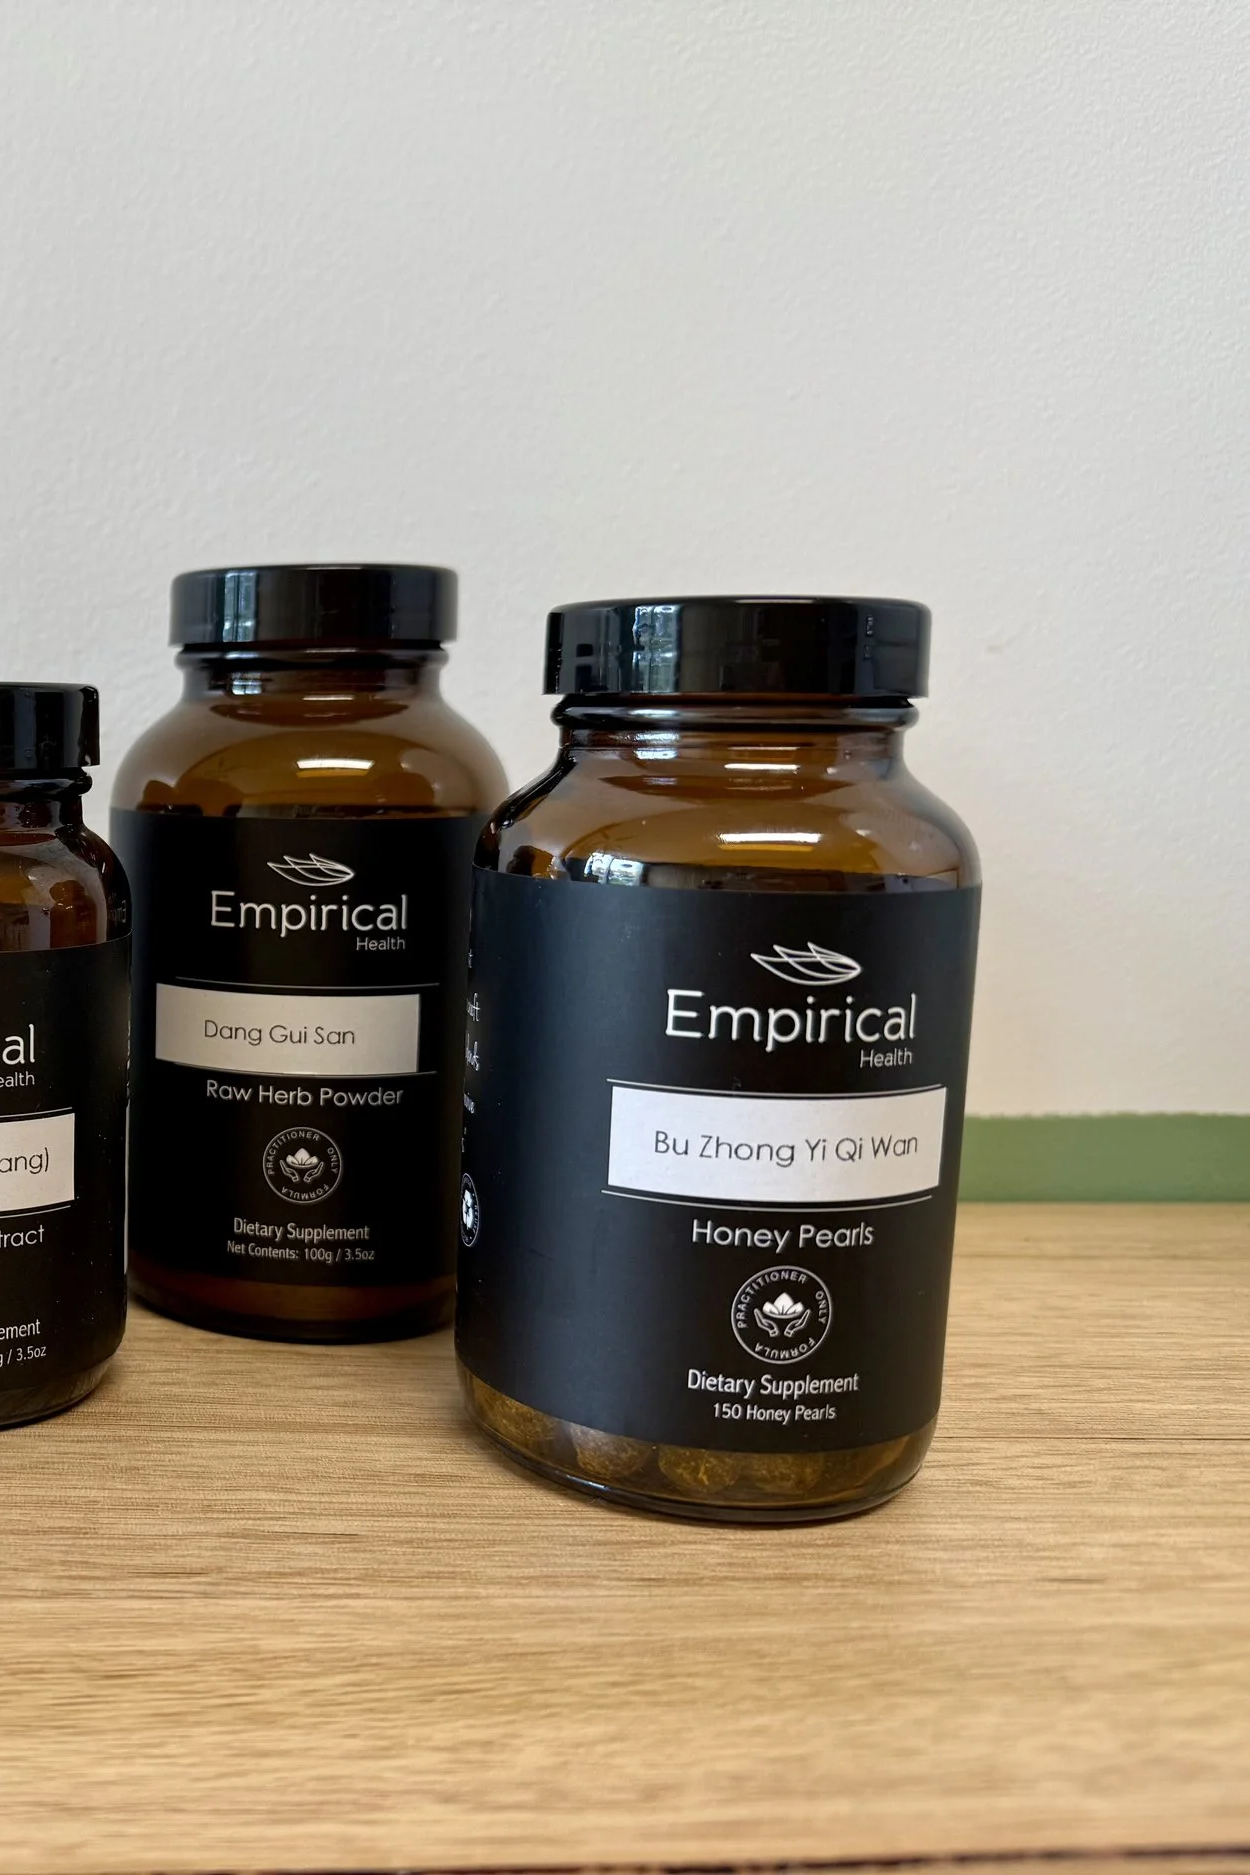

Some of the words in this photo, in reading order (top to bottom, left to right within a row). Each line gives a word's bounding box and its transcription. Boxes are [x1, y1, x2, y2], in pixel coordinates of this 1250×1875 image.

[210, 890, 408, 937] Empirical
[356, 936, 406, 951] Health
[204, 1019, 262, 1046] Dang
[269, 1024, 307, 1045] Gui
[313, 1026, 355, 1045] San
[666, 989, 916, 1052] Empirical
[860, 1048, 913, 1069] Health
[206, 1079, 251, 1102] Raw
[258, 1085, 312, 1106] Herb
[319, 1087, 404, 1107] Powder
[266, 1131, 320, 1175] PRACTITIONER
[327, 1147, 339, 1174] ONLY
[654, 1130, 689, 1156] Bu
[699, 1133, 795, 1168] Zhong
[805, 1137, 827, 1162] Yi
[834, 1136, 863, 1163] Qi
[871, 1134, 918, 1157] Wan
[281, 1184, 329, 1200] FORMULA
[233, 1217, 283, 1240] Dietary
[286, 1222, 370, 1243] Supplement
[691, 1220, 790, 1253] Honey
[799, 1221, 874, 1248] Pearls
[227, 1240, 246, 1255] Net
[247, 1244, 299, 1259] Contents:
[304, 1247, 333, 1264] 100g
[344, 1248, 375, 1262] 3.5oz
[736, 1270, 807, 1329] PRACTITIONER
[815, 1290, 828, 1324] ONLY
[16, 1345, 47, 1362] 3.5oz
[754, 1337, 816, 1359] FORMULA
[687, 1369, 755, 1398] Dietary
[760, 1372, 859, 1399] Supplement
[713, 1403, 742, 1421] 150
[746, 1404, 790, 1425] Honey
[794, 1402, 836, 1421] Pearls
